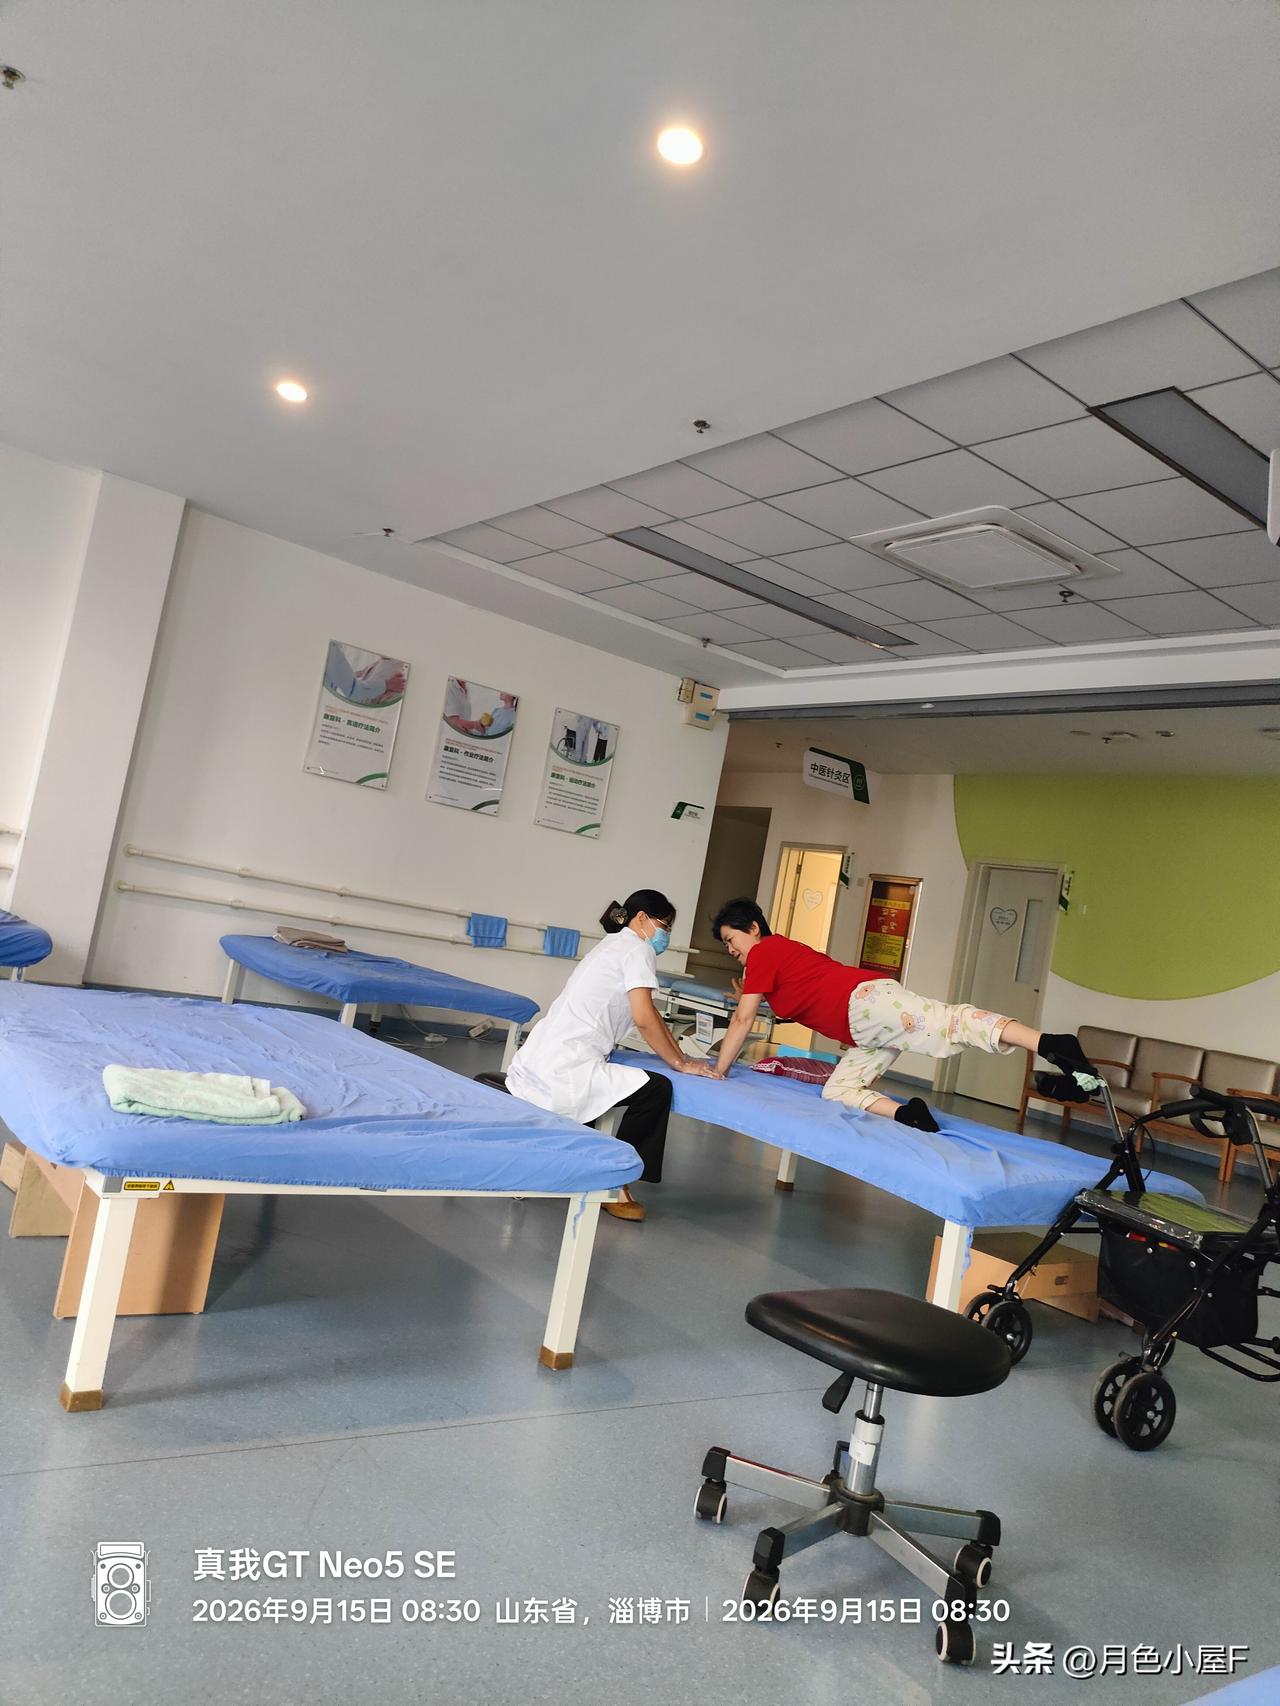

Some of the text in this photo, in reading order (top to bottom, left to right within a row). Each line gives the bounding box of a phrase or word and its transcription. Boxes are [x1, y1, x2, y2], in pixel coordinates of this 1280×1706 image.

[810, 762, 850, 784] 中医针灸区
